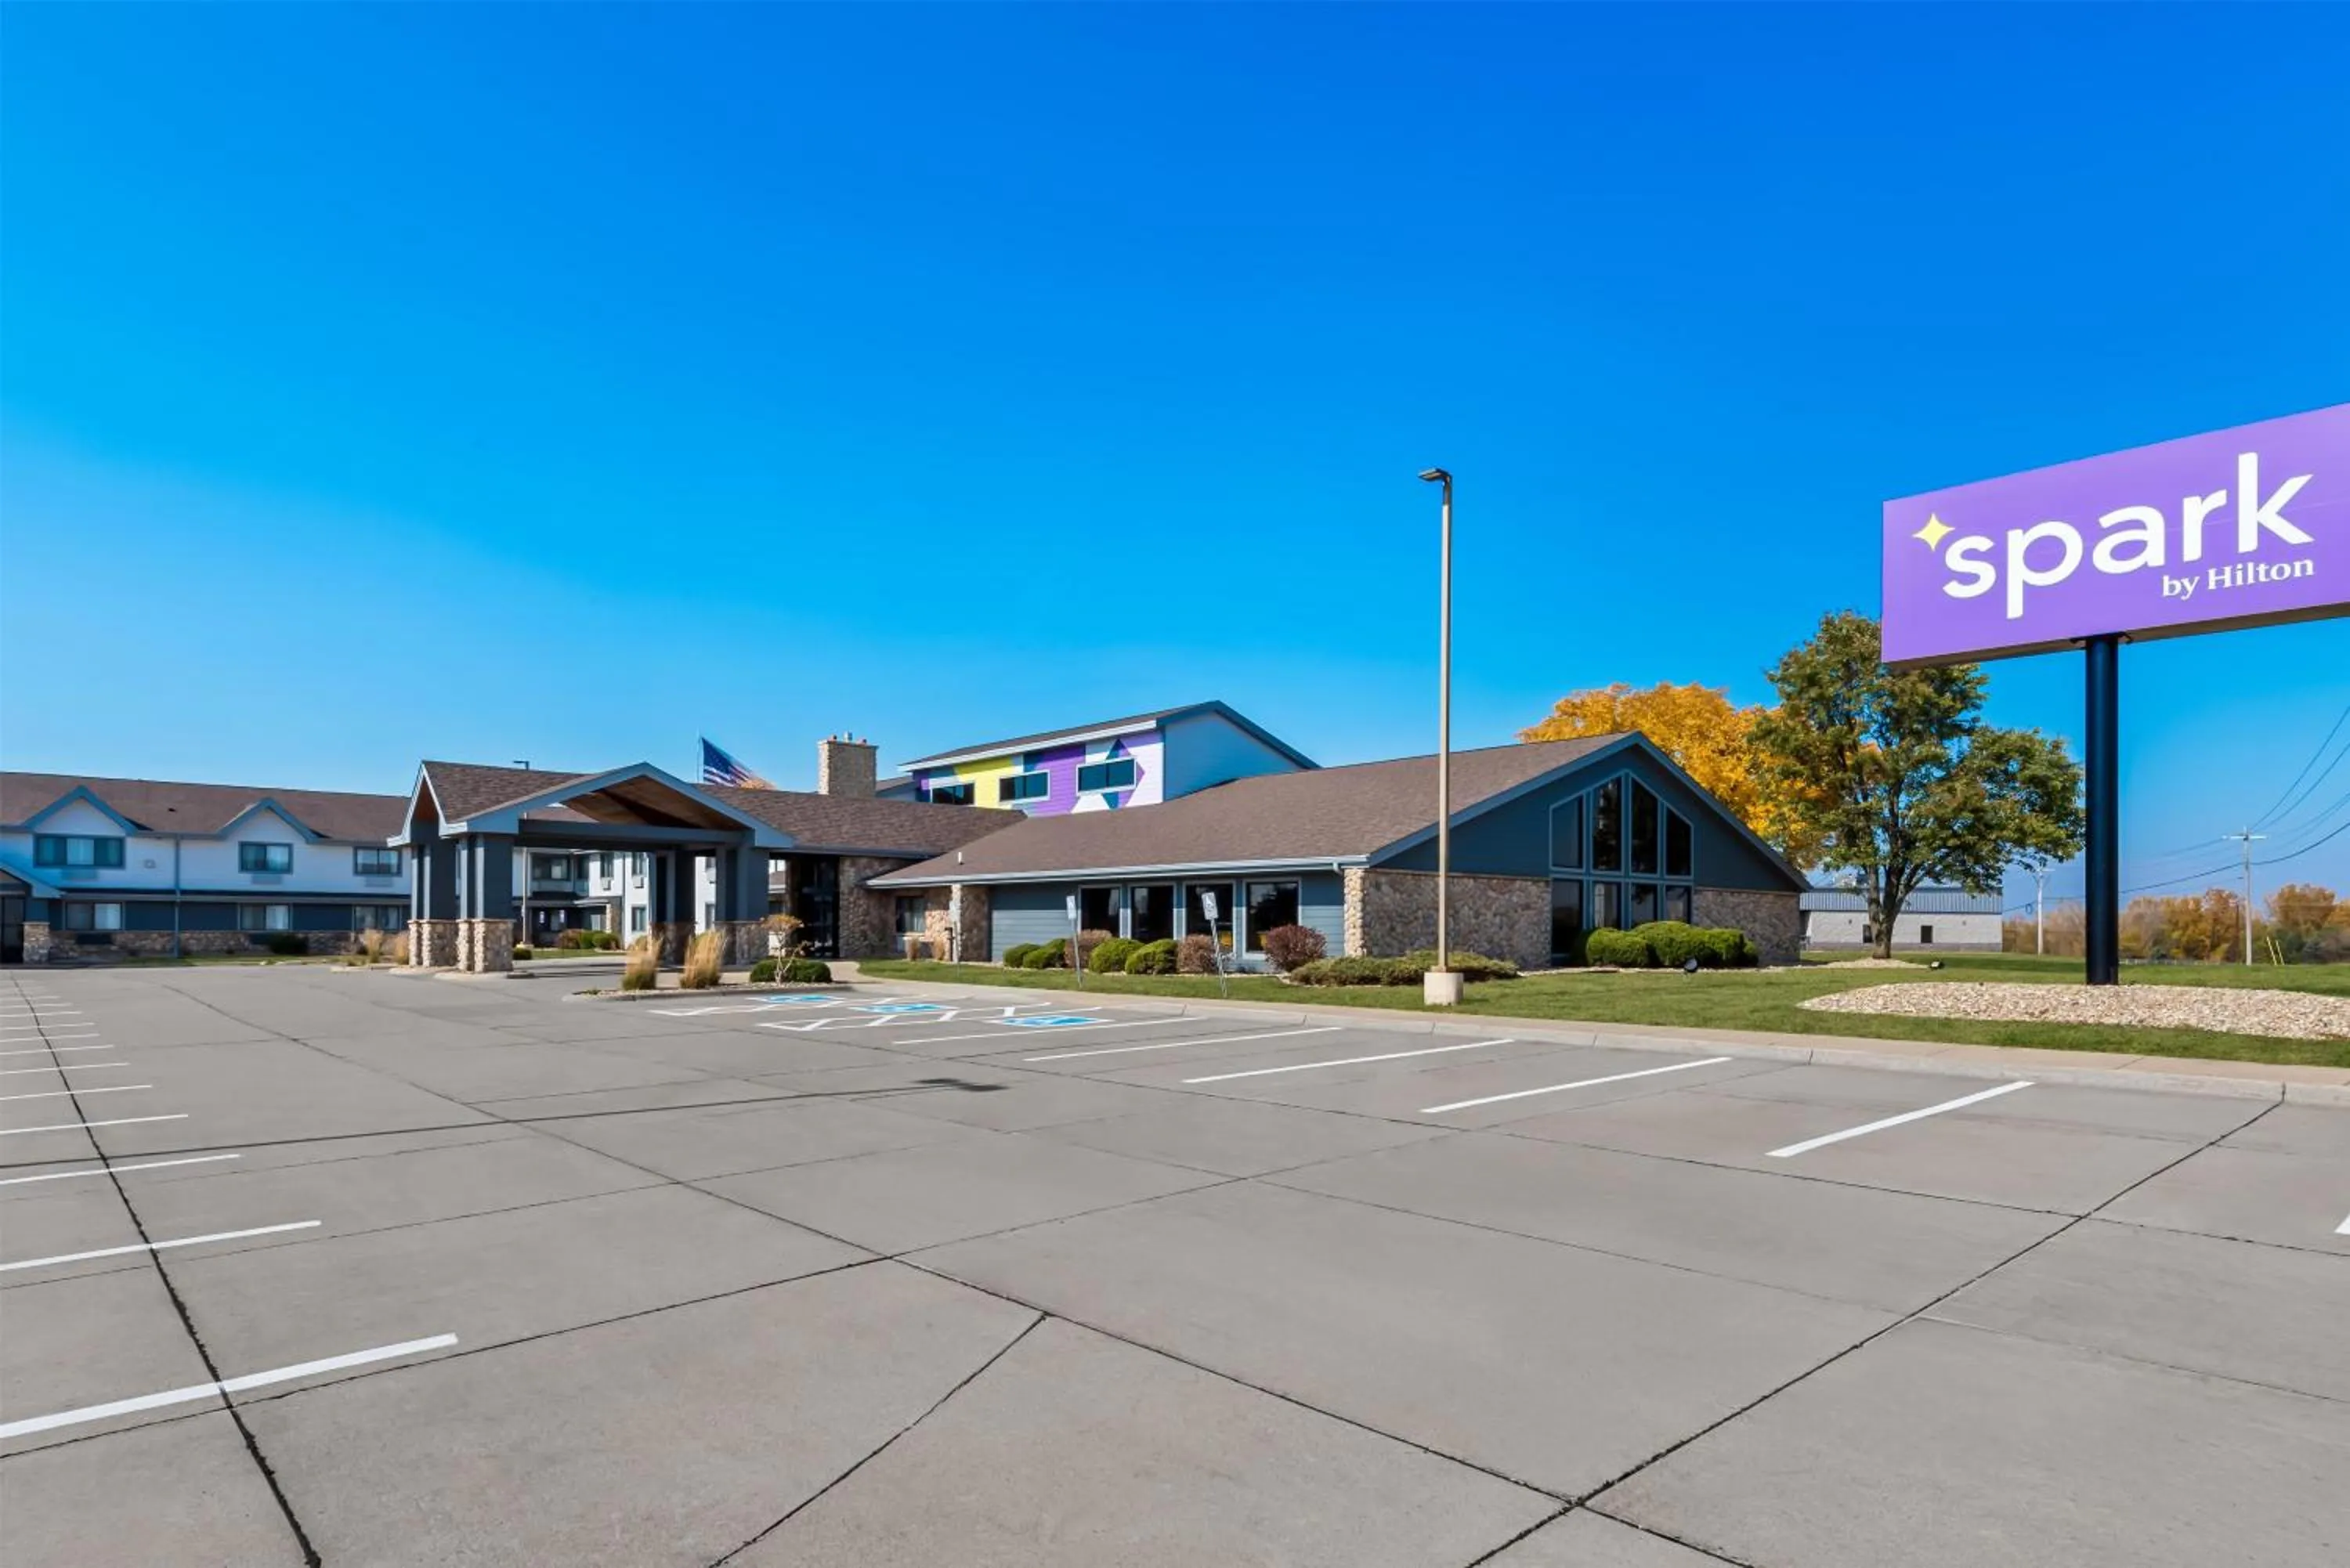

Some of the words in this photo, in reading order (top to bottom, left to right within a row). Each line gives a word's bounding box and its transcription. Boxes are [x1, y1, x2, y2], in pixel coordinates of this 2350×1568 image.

[1942, 451, 2315, 619] spark
[2162, 574, 2200, 601] by
[2207, 559, 2315, 590] Hilton
